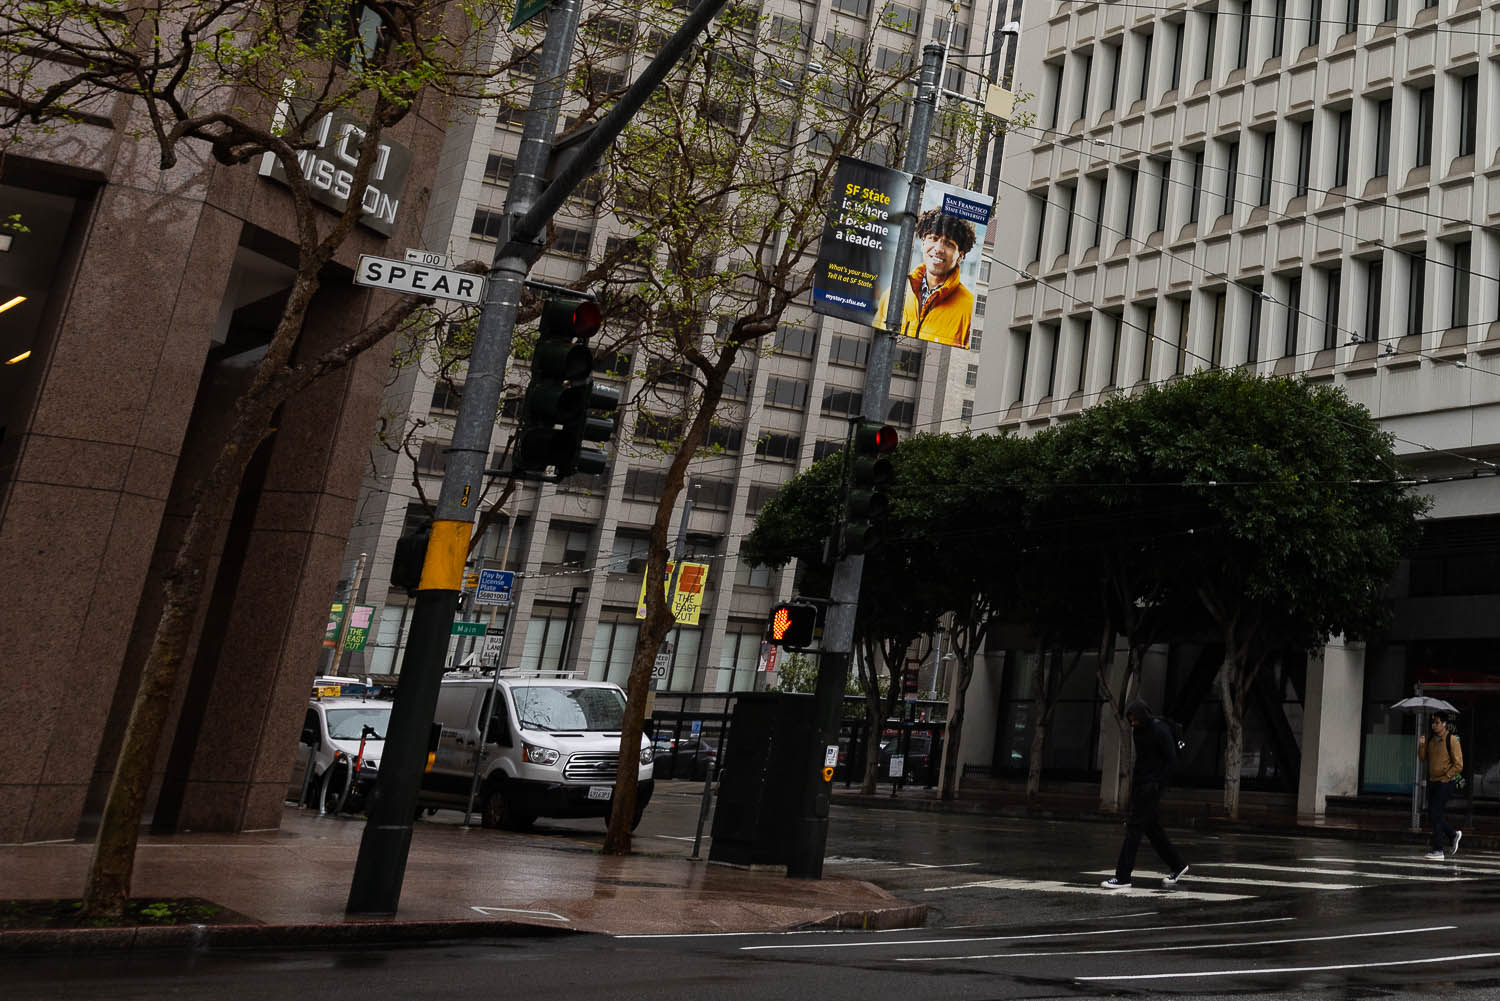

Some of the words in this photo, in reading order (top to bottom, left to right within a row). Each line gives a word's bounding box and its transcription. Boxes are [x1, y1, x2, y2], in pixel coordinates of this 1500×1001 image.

[280, 150, 399, 225] ISSON
[845, 184, 861, 198] SF
[861, 190, 891, 207] State
[842, 197, 852, 212] is
[855, 205, 889, 223] where
[946, 197, 957, 206] SAN
[958, 201, 988, 215] FRANCISCO
[945, 205, 958, 214] STATE
[959, 209, 986, 222] UNIVERSITY
[836, 233, 843, 242] a
[845, 234, 883, 252] leader.
[423, 255, 440, 264] 100
[828, 263, 848, 273] What's
[847, 268, 861, 276] your
[861, 271, 878, 281] story?
[366, 263, 474, 297] SPEAR
[827, 271, 837, 280] Tell
[849, 277, 858, 285] SF
[857, 279, 873, 289] State.
[461, 496, 468, 507] 2
[482, 571, 494, 579] Pay
[480, 583, 497, 591] Plate
[679, 594, 696, 604] THE
[676, 603, 697, 614] EAST
[675, 612, 692, 622] CUT
[457, 625, 477, 633] Main
[346, 635, 365, 643] EAST
[345, 642, 361, 650] CUT
[652, 667, 665, 676] 20
